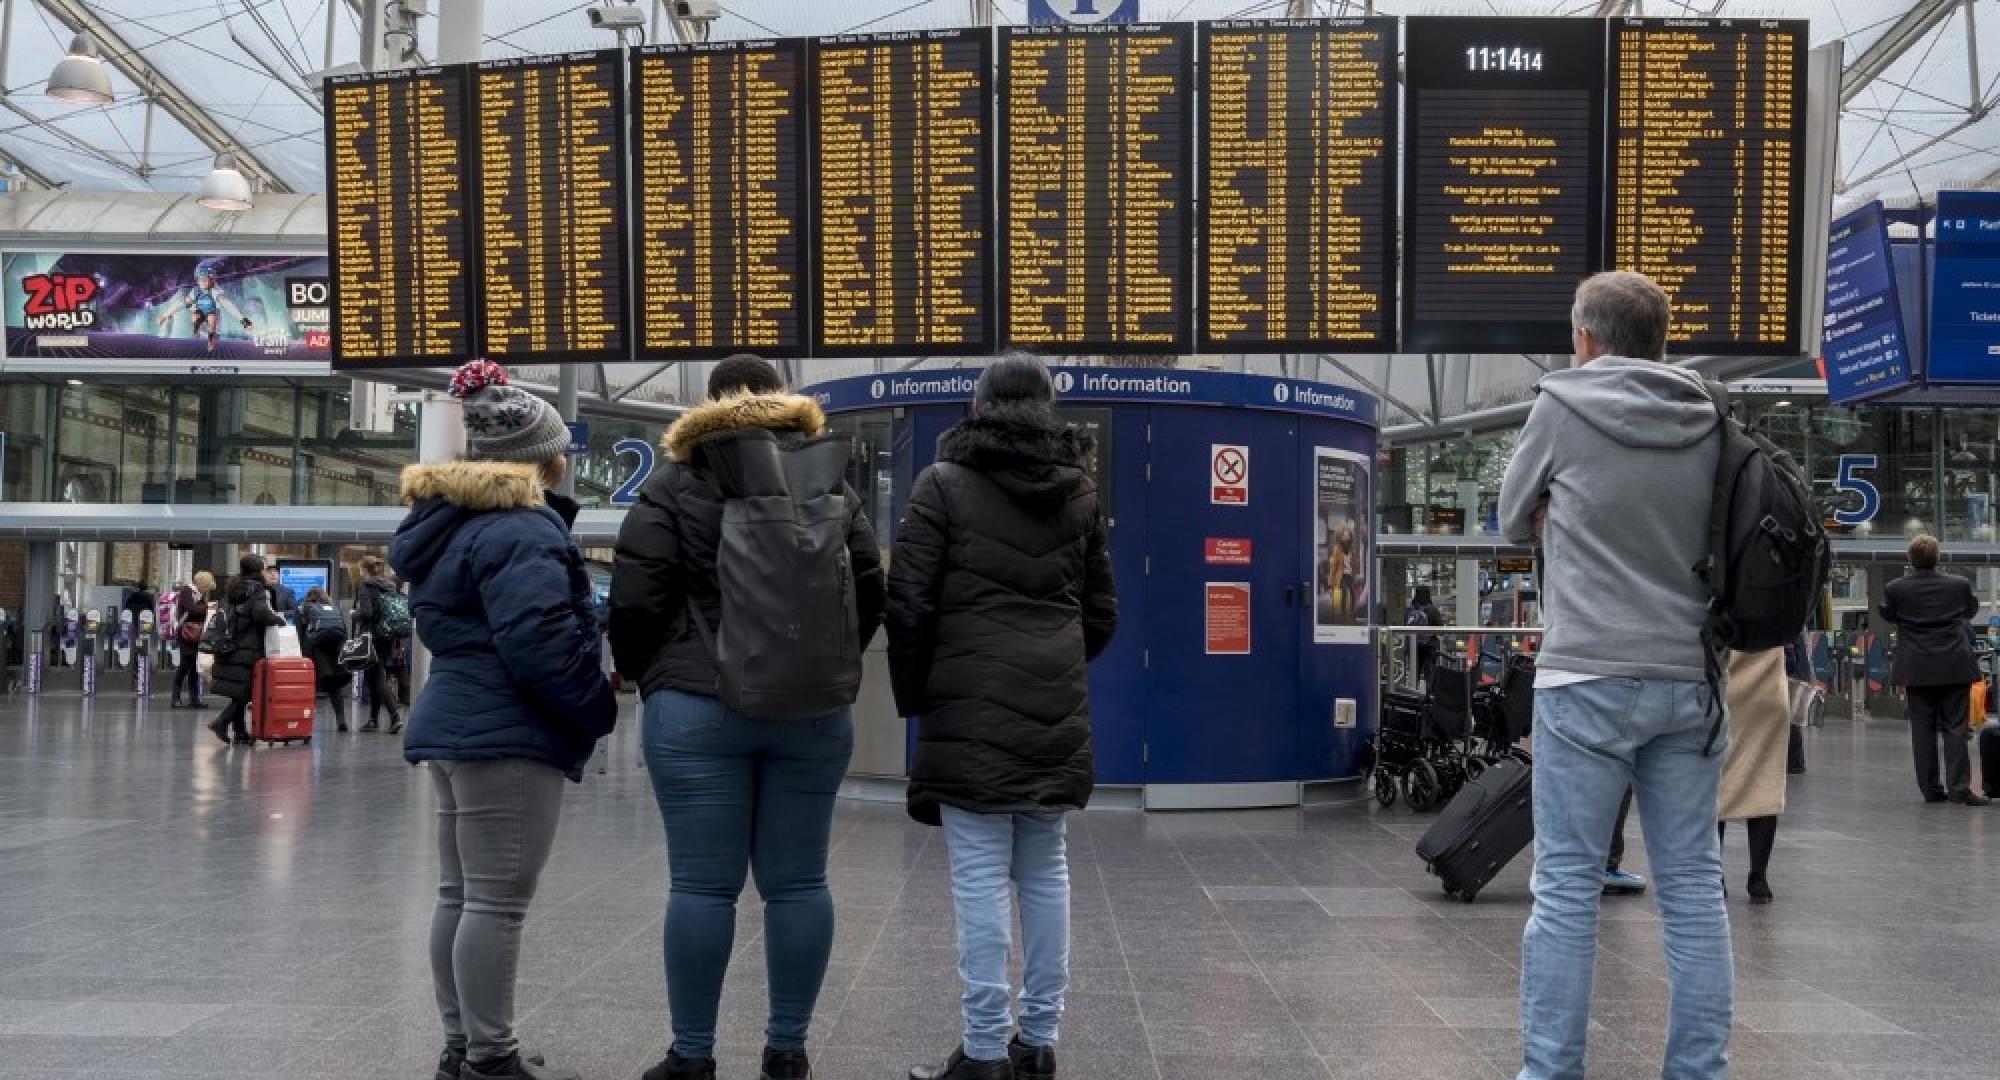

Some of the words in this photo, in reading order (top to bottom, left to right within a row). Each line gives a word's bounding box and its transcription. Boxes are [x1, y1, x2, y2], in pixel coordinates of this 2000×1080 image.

[27, 312, 93, 330] WORLD
[1083, 375, 1191, 395] Information
[1295, 387, 1355, 412] Information
[610, 437, 655, 504] 2
[1834, 454, 1880, 524] 5
